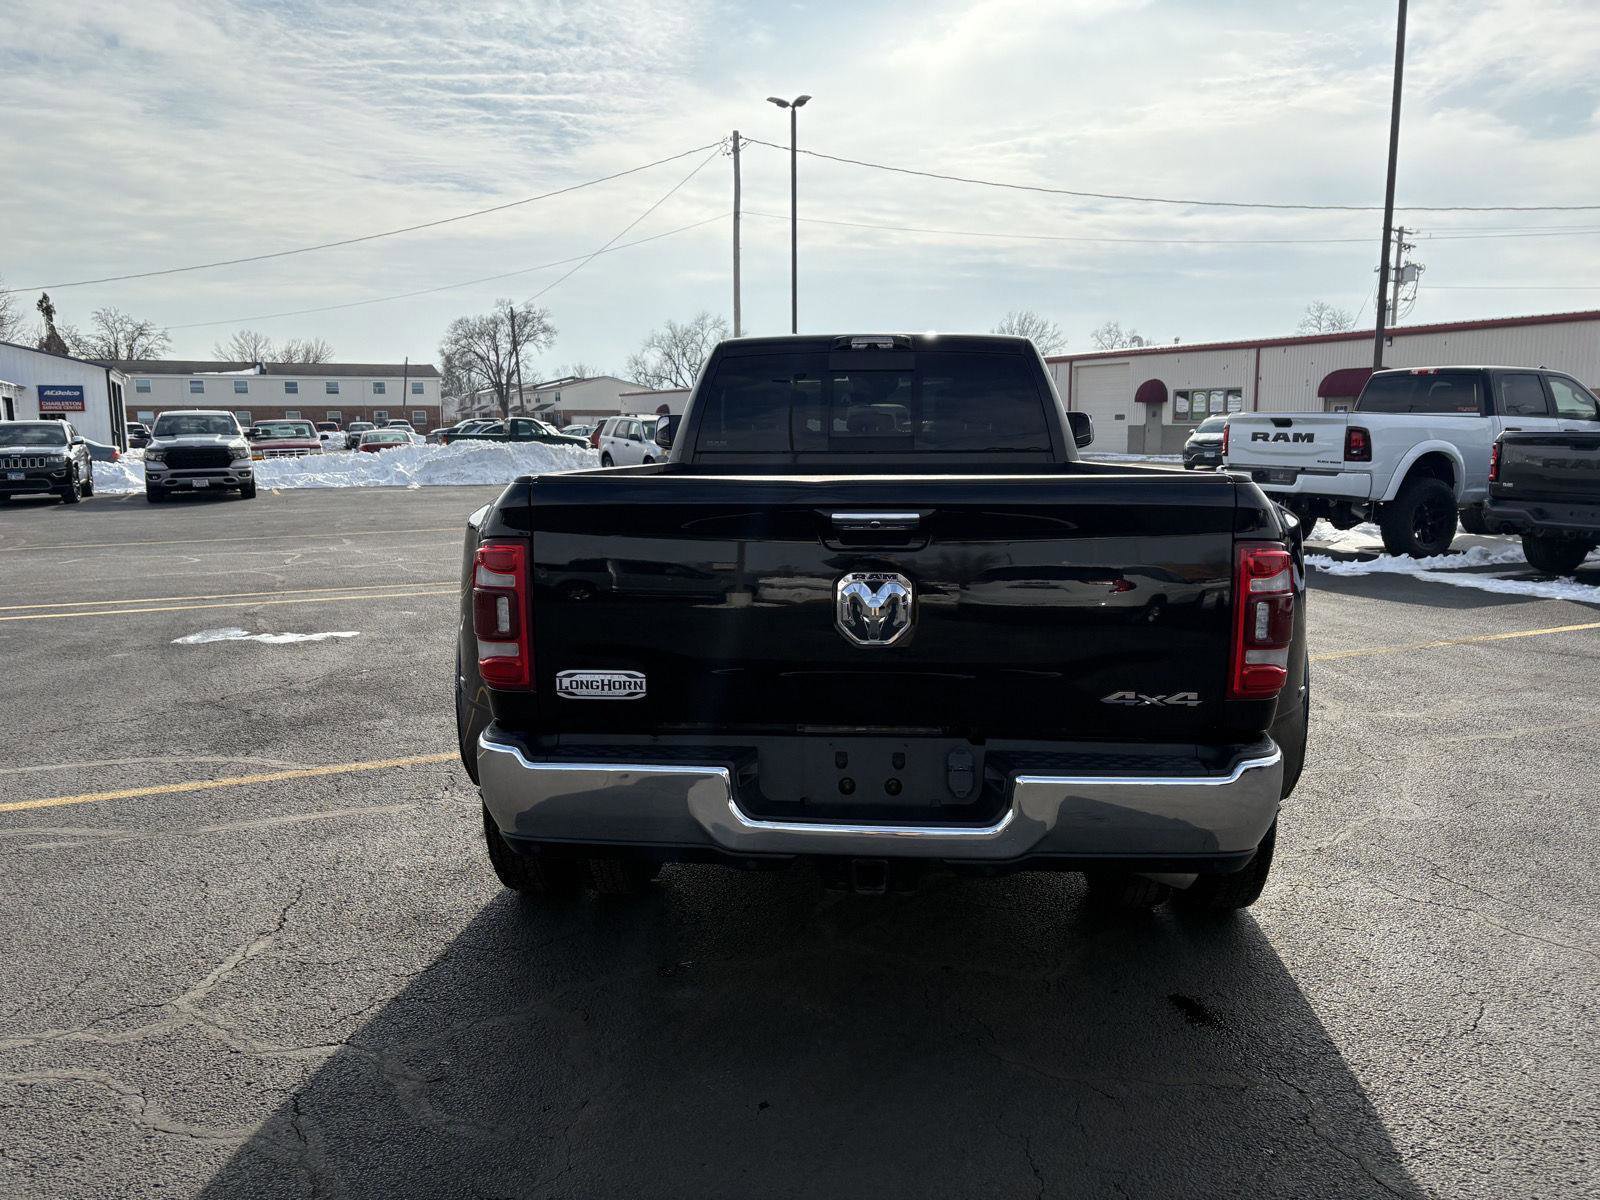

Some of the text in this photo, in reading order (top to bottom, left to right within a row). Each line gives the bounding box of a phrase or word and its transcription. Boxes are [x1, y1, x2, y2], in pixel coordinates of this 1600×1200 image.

[1251, 432, 1315, 443] RAM
[1542, 459, 1600, 470] RA
[558, 679, 644, 691] LONGHORN
[1100, 692, 1202, 706] 4x4
